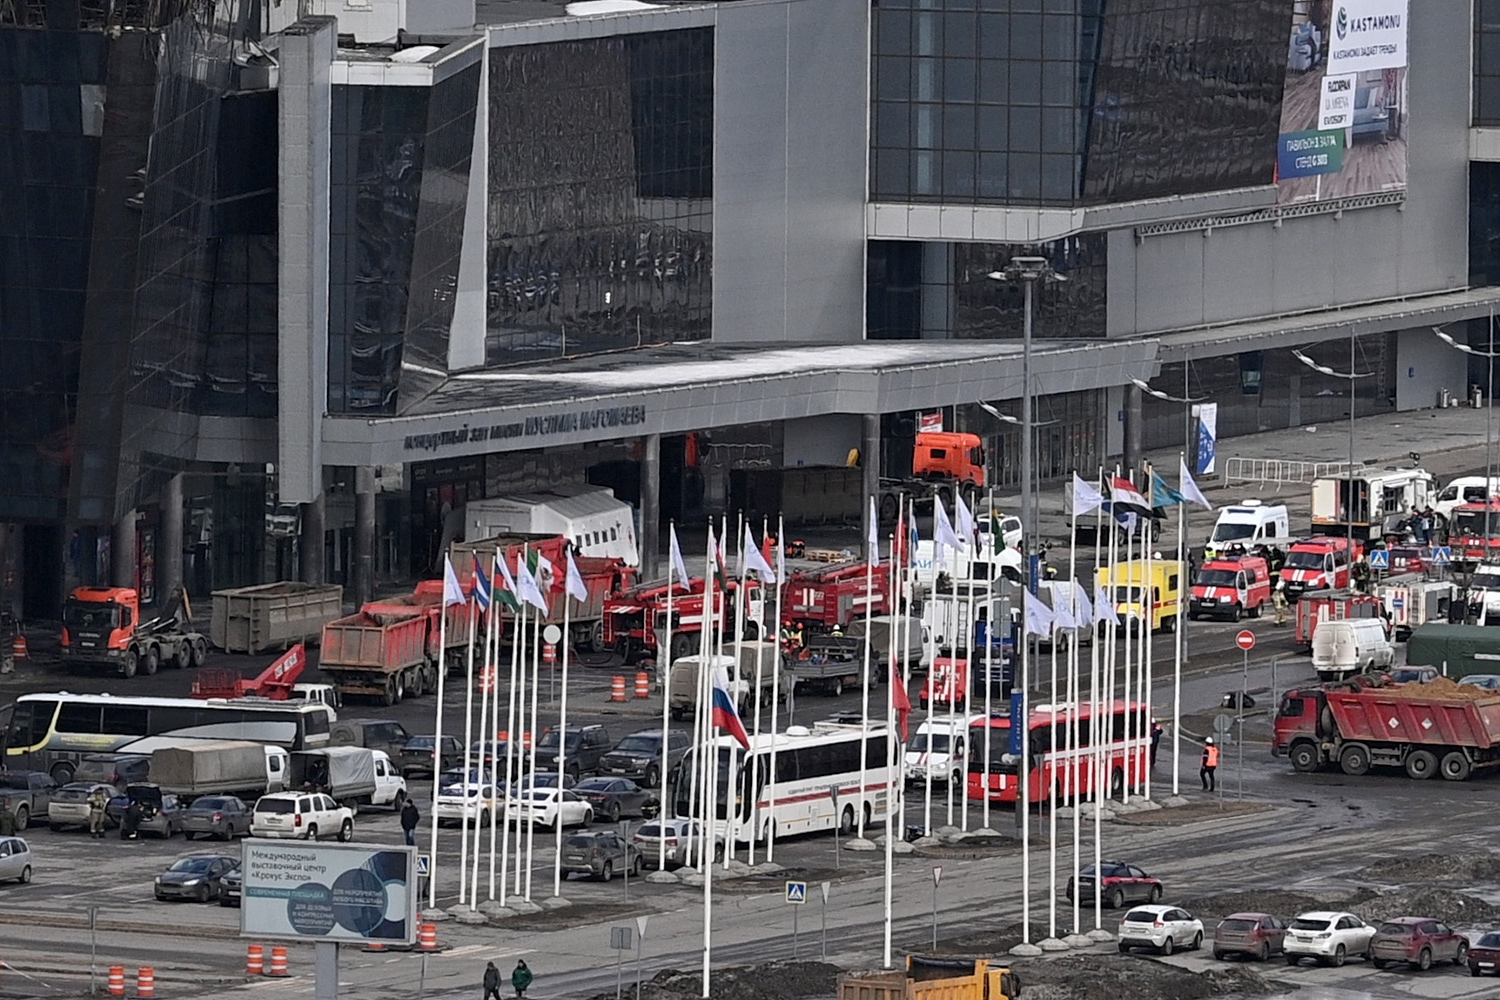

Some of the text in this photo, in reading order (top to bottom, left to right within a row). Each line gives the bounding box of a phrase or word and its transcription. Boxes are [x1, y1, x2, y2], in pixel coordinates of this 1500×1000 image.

[1350, 14, 1401, 33] KASTAMONU
[251, 850, 316, 861] Международный
[251, 862, 327, 874] выставочный центр
[251, 871, 311, 881] «Крокус Экспо»
